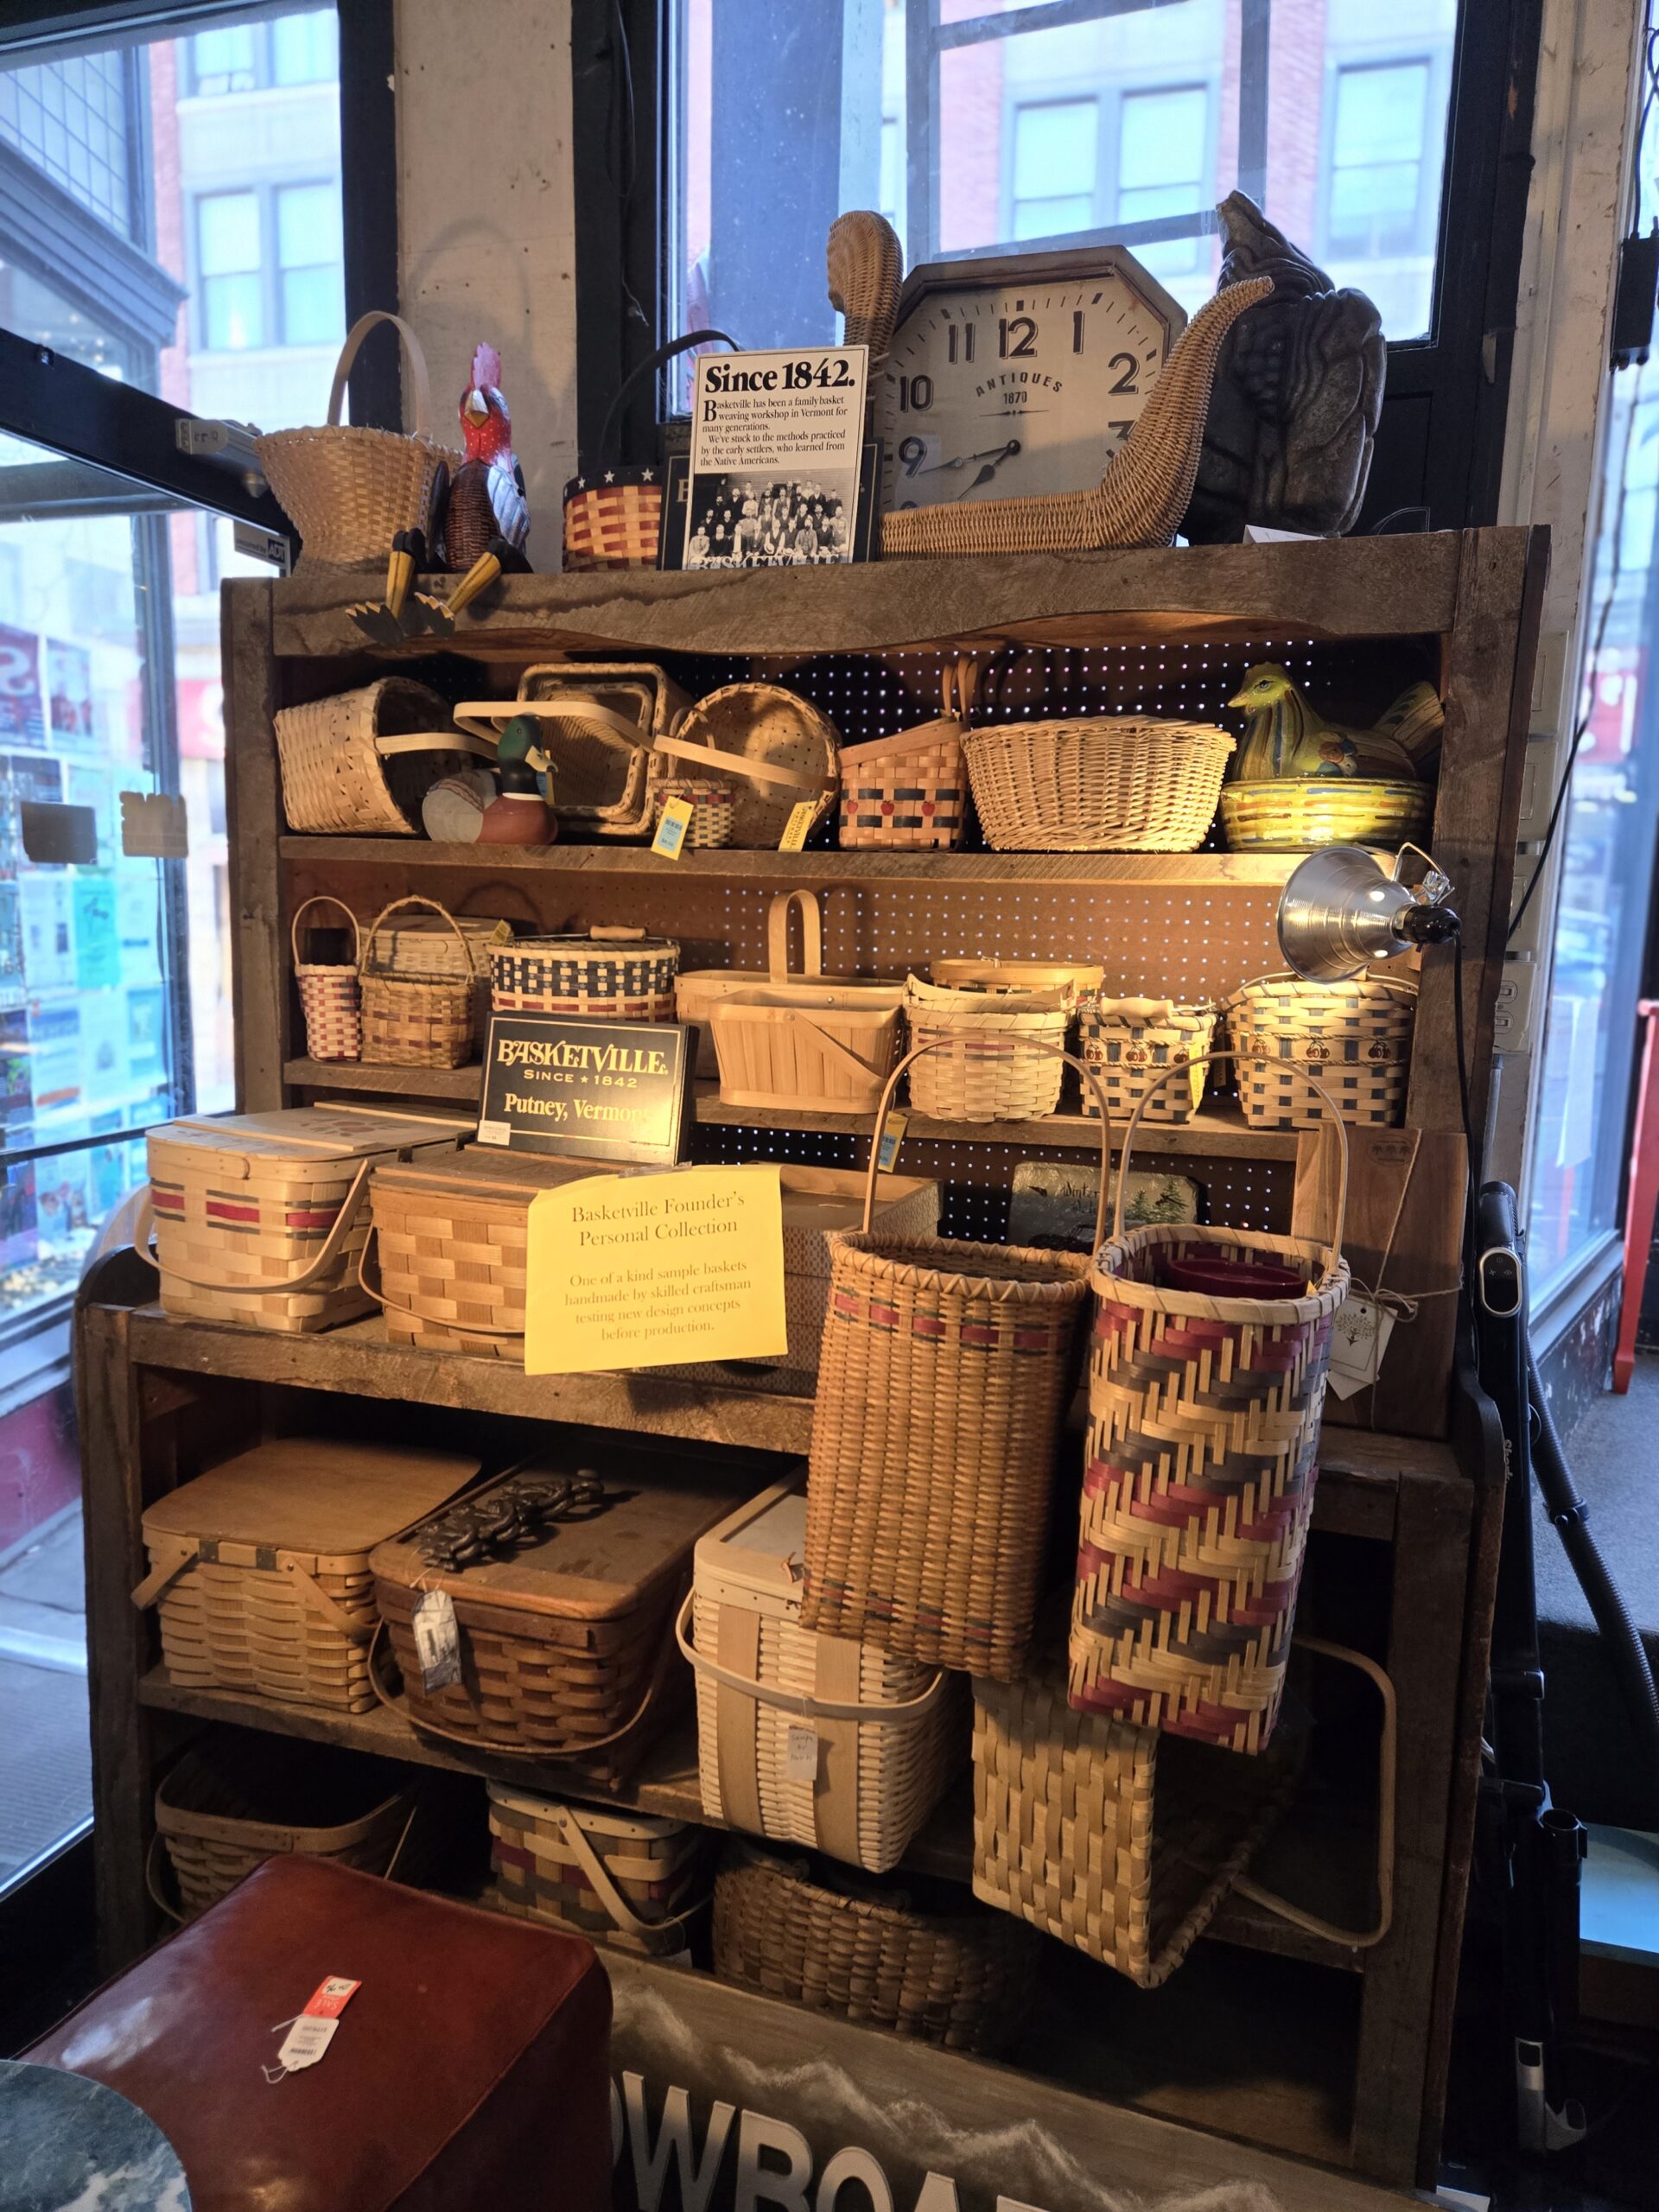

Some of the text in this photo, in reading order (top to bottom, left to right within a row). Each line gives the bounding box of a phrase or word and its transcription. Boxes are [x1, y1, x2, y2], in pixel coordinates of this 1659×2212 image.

[949, 322, 975, 364] 11
[999, 316, 1039, 359] 12
[1072, 310, 1084, 354] 1
[705, 358, 855, 393] Since 1842.
[976, 372, 1063, 397] ANTIQUES
[1108, 352, 1139, 396] 2
[753, 398, 766, 408] has
[768, 397, 786, 407] been
[794, 397, 818, 407] family
[819, 395, 843, 405] basket
[899, 374, 933, 413] 10
[1003, 391, 1027, 404] 1870
[719, 406, 848, 422] weaving workshop in Vermont for
[702, 422, 771, 435] many generations.
[709, 435, 729, 443] We've
[731, 433, 751, 442] stuck
[762, 432, 774, 442] the
[776, 431, 809, 441] methods
[810, 429, 846, 442] practiced
[700, 455, 779, 466] the Native Americans.
[701, 441, 845, 457] by the early settlers, who learned from
[899, 436, 927, 478] 9
[524, 1069, 638, 1088] SINCE 1842
[503, 1092, 568, 1122] Putney,
[573, 1191, 745, 1223] Basketville Founder's
[580, 1218, 737, 1246] Personal Collection
[569, 1260, 747, 1287] One of a kind sample baskets
[564, 1281, 751, 1306] handmade by skilled craftsman
[575, 1300, 741, 1324] testing new design concepts
[601, 1319, 715, 1341] before production.
